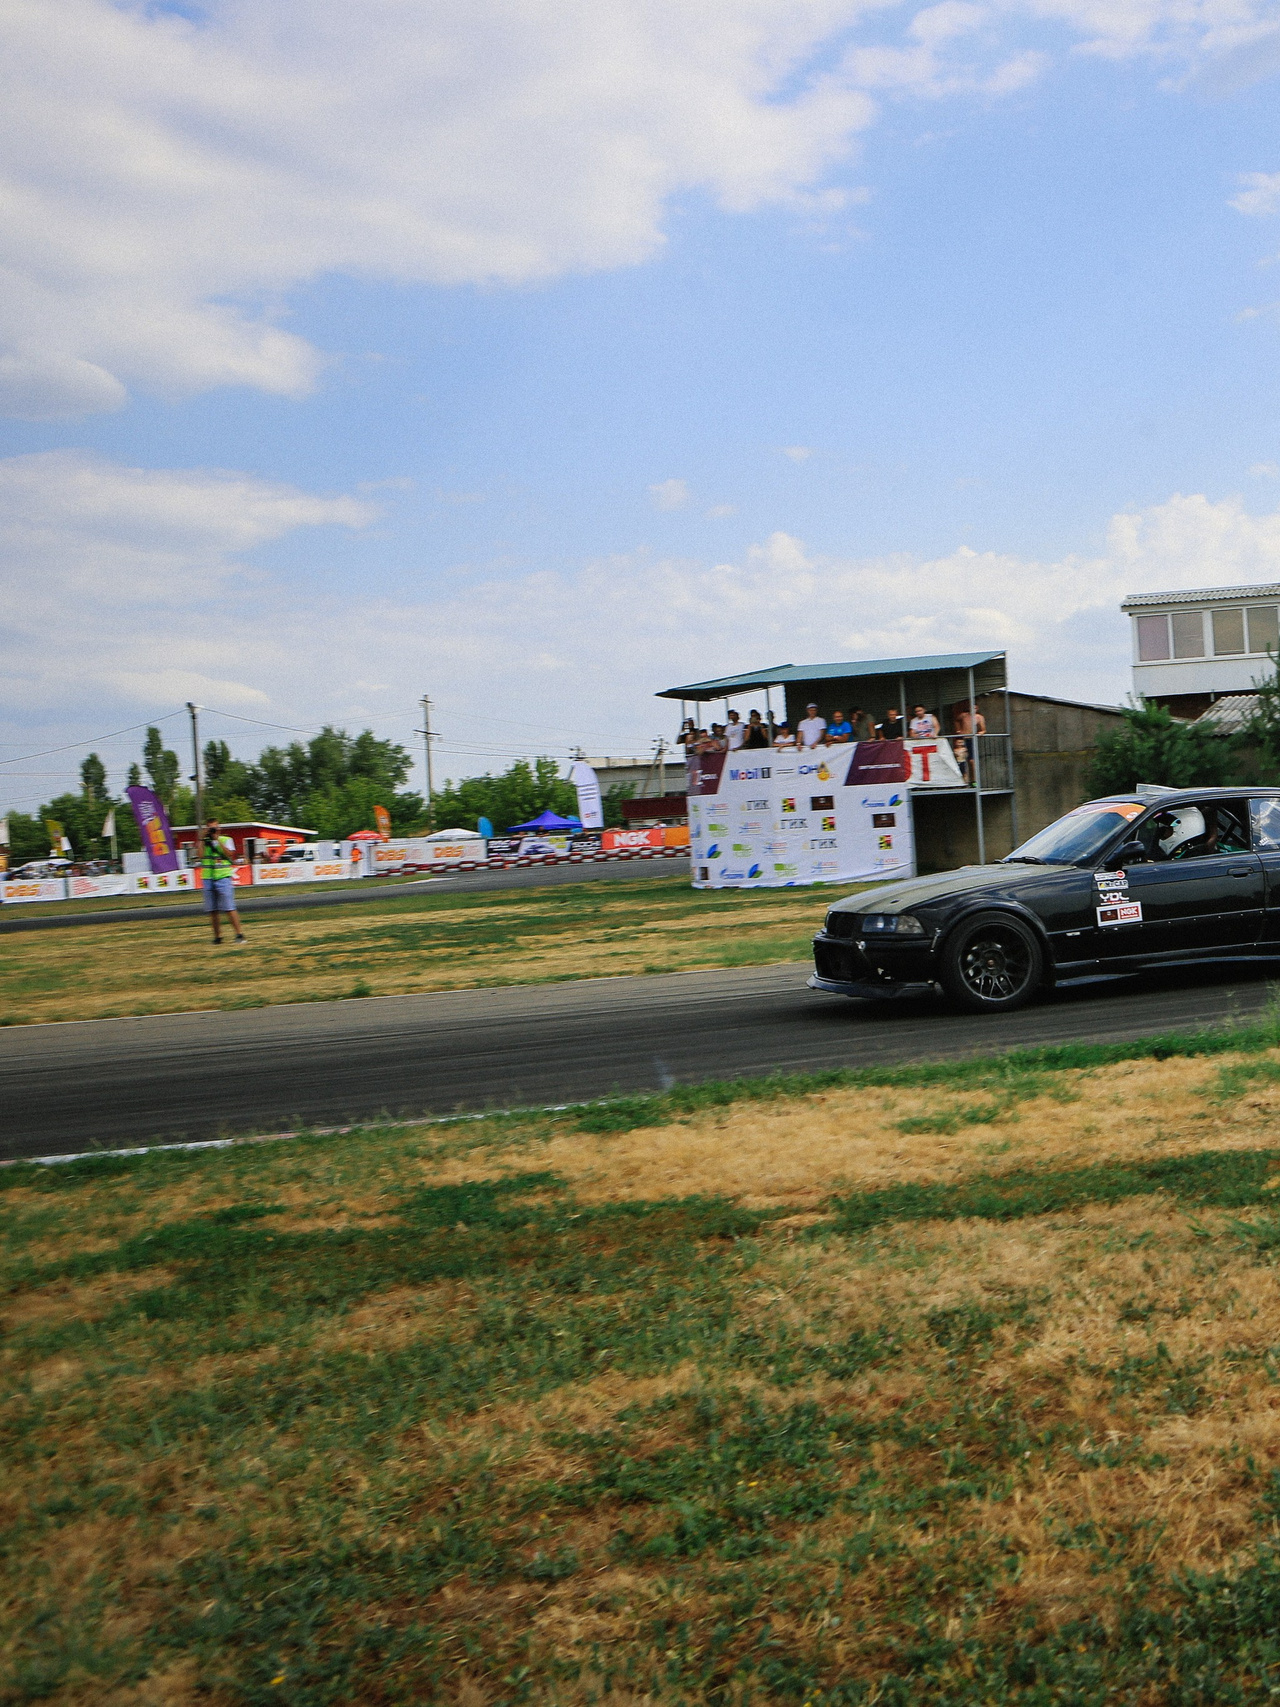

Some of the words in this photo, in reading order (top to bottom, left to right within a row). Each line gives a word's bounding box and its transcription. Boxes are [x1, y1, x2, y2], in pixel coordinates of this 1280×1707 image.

[729, 767, 759, 781] Mobil
[613, 831, 651, 847] NGK
[1120, 907, 1138, 916] NGK
